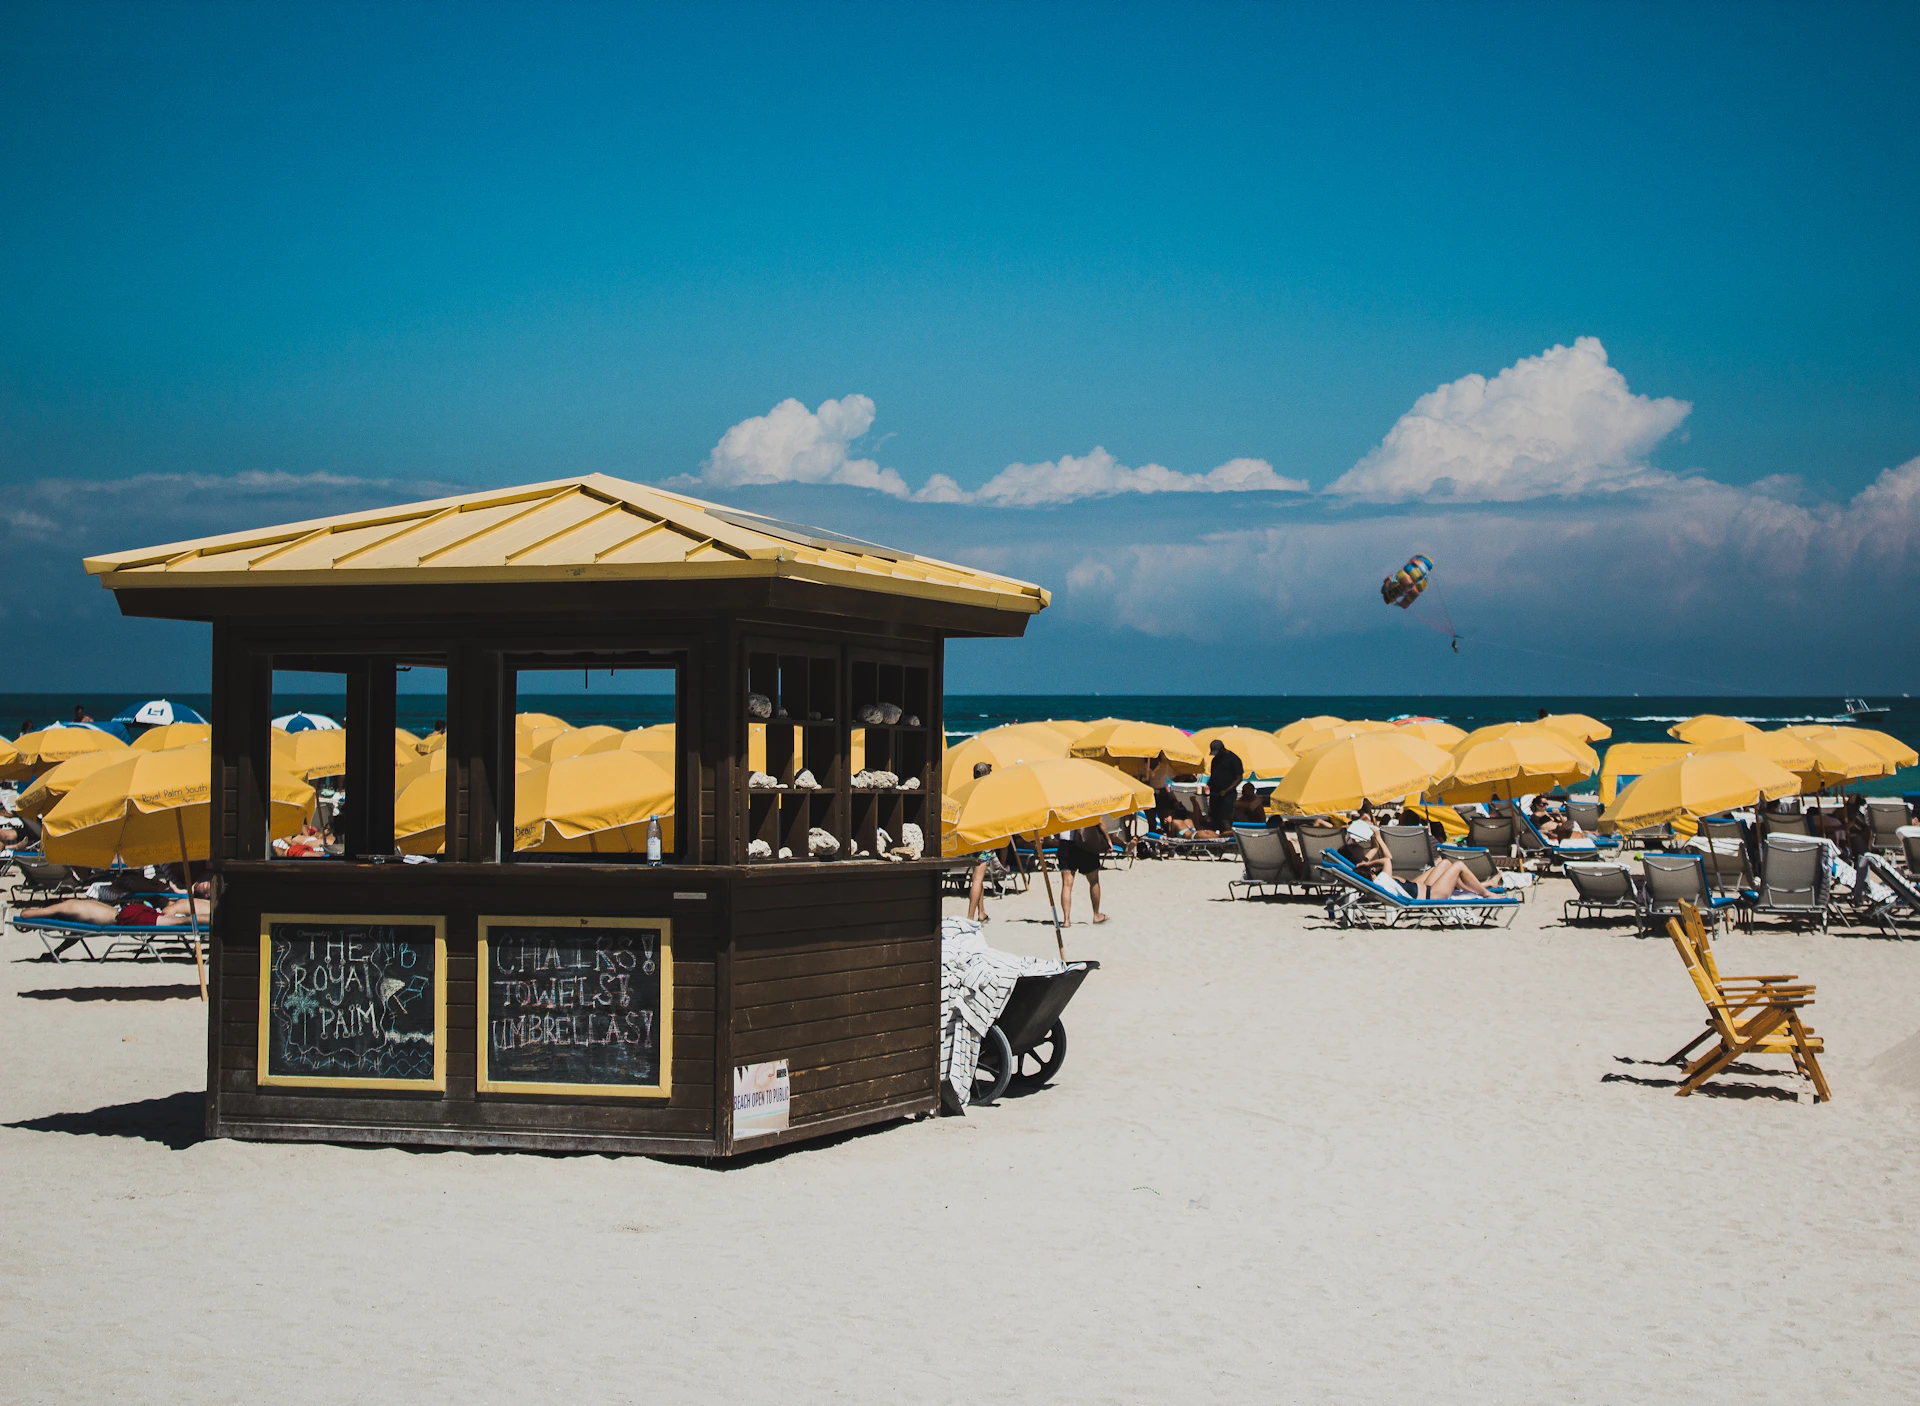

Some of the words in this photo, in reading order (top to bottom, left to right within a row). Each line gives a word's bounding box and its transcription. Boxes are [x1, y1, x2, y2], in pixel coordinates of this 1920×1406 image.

[141, 791, 161, 804] Royal
[163, 788, 183, 798] Palm
[185, 782, 208, 794] South
[297, 930, 369, 963] THE
[733, 1092, 751, 1111] BEACH
[751, 1090, 765, 1108] OPEN
[765, 1088, 773, 1105] TO
[773, 1085, 790, 1104] PUBLIC
